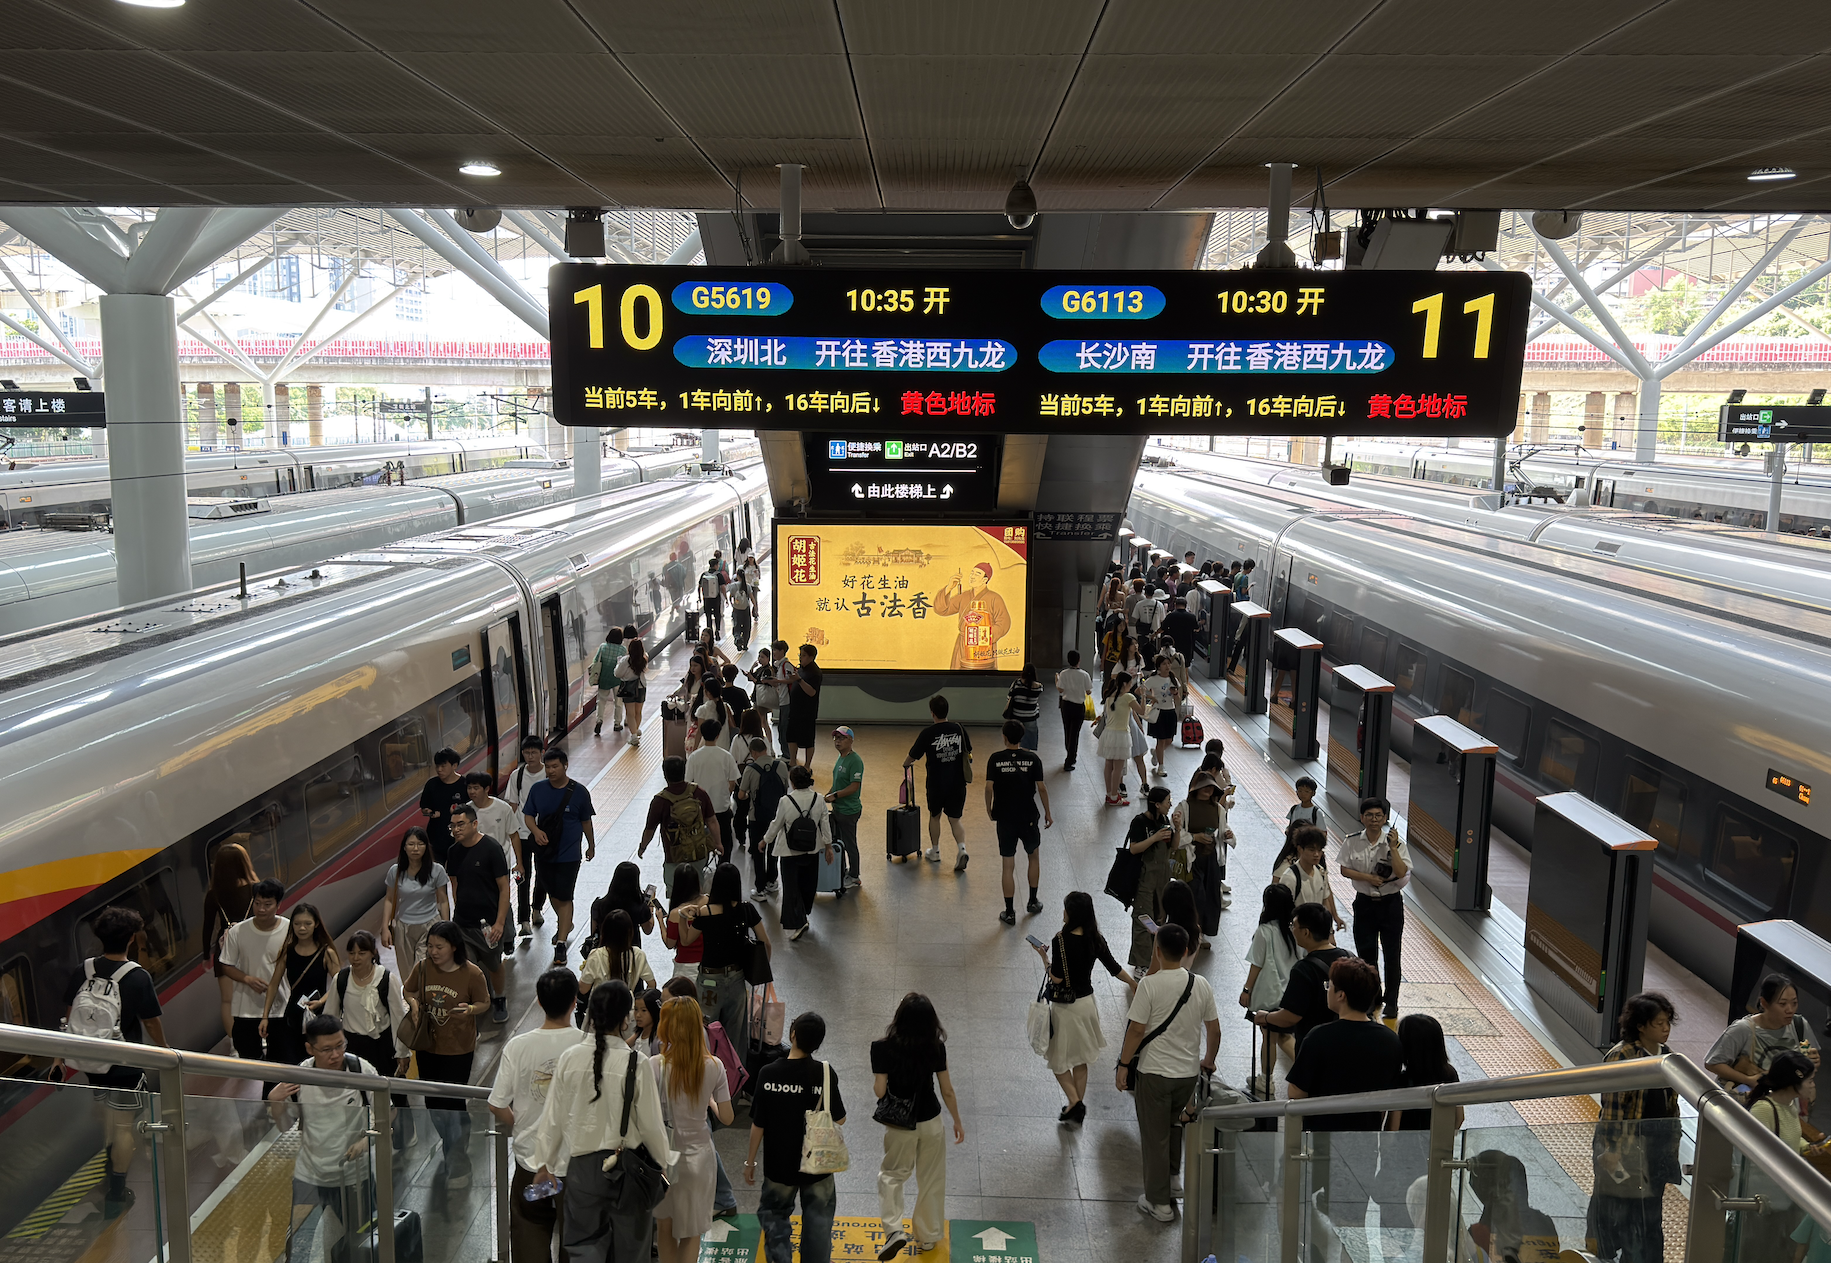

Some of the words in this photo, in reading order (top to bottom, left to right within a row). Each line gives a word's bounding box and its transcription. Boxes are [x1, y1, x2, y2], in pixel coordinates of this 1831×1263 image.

[691, 286, 771, 310] G5619
[846, 288, 914, 312] 10:35
[924, 287, 950, 315] 开
[1062, 290, 1143, 313] G6113
[1217, 290, 1287, 314] 10:30
[1297, 287, 1324, 316] 开
[573, 283, 665, 351] 10
[1411, 292, 1495, 359] 11
[707, 338, 787, 366] 深圳北
[1076, 342, 1157, 370] 长沙南
[901, 390, 996, 416] 黄色地标
[1367, 393, 1467, 419] 黄色地标
[847, 442, 882, 452] 便捷换乘
[904, 443, 927, 452] 出站口
[928, 443, 977, 458] A2/B2
[867, 483, 937, 499] 由此楼梯上
[792, 539, 807, 582] 胡姬花
[842, 574, 909, 590] 好花生油
